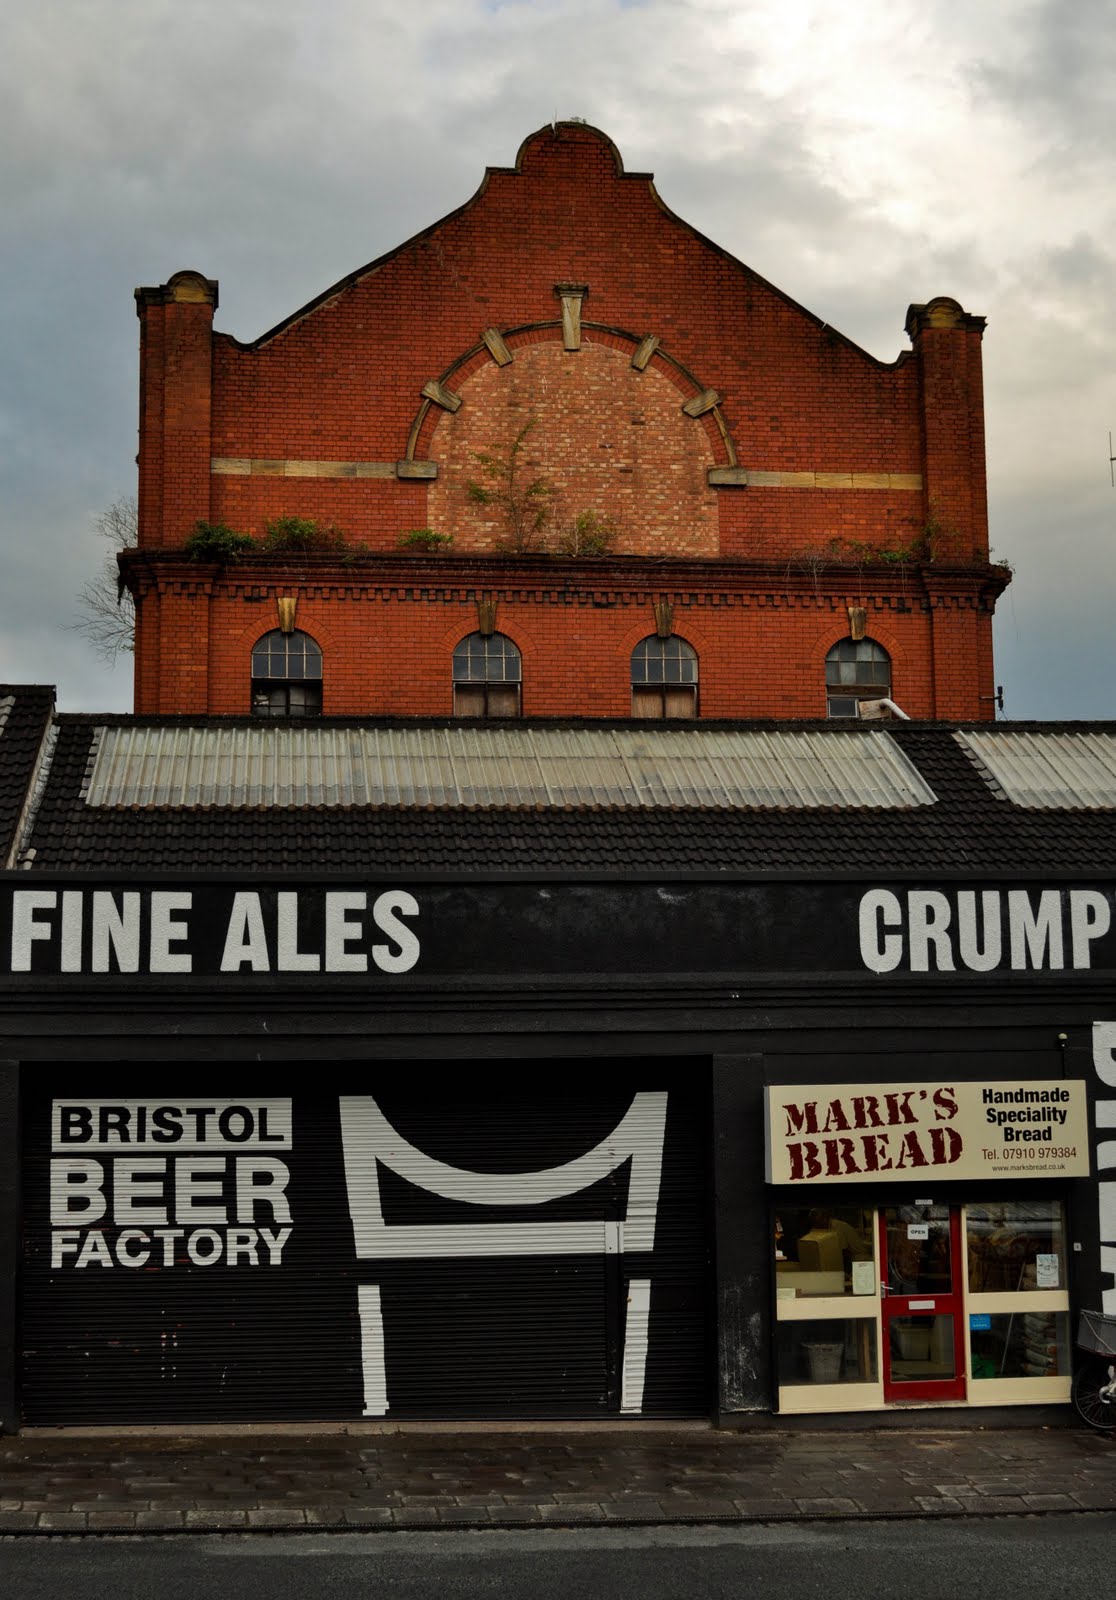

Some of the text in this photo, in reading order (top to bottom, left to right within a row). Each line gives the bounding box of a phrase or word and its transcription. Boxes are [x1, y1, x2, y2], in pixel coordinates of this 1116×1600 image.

[10, 889, 421, 974] FINE ALES
[858, 888, 1112, 974] CRUMP
[782, 1087, 960, 1137] MARK'S
[982, 1087, 1070, 1104] Handmade
[59, 1105, 285, 1144] BRISTOL
[986, 1106, 1068, 1127] Speciality
[1003, 1125, 1053, 1142] Bread
[785, 1127, 964, 1181] BREAD
[981, 1146, 1077, 1160] Tel. 07910 979384
[991, 1163, 1067, 1172] www.marksbread.co.uk
[49, 1156, 294, 1226] BEER
[50, 1227, 294, 1269] FACTORY
